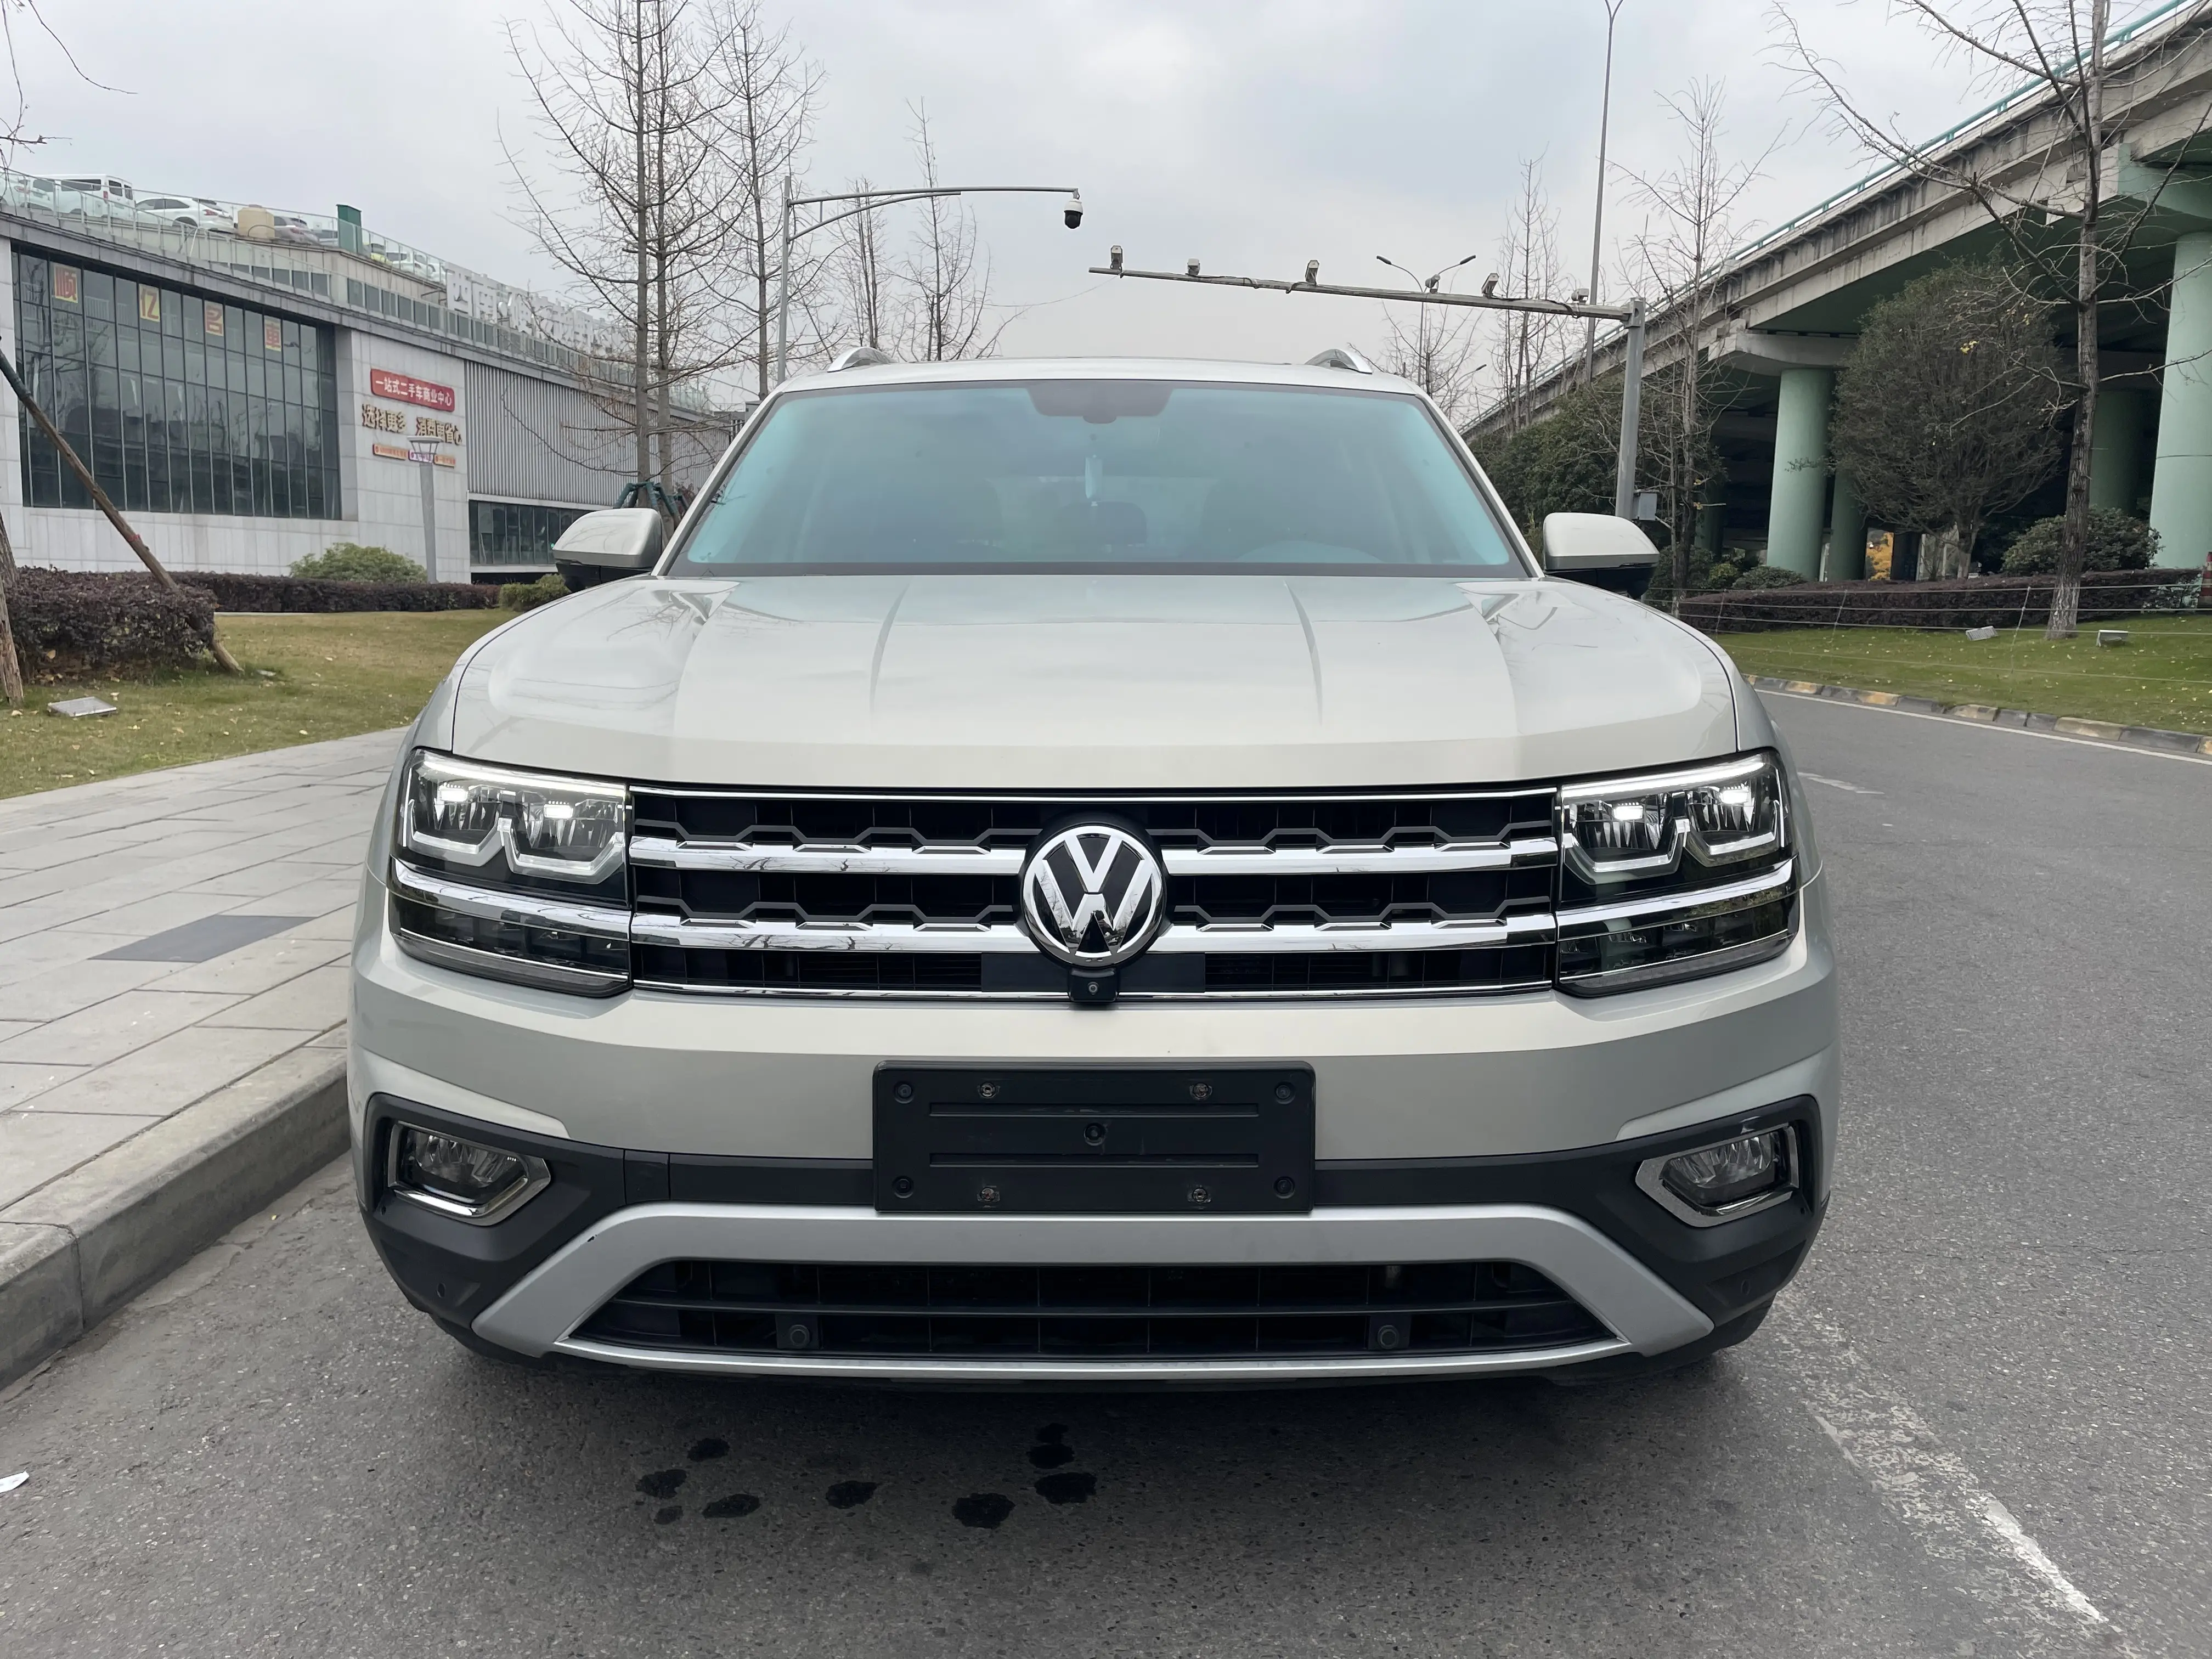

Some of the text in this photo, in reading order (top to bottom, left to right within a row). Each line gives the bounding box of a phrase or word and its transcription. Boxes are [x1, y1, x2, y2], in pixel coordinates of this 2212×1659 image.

[375, 377, 453, 407] 一站式二手车商业中心
[362, 403, 407, 433] 选择更多
